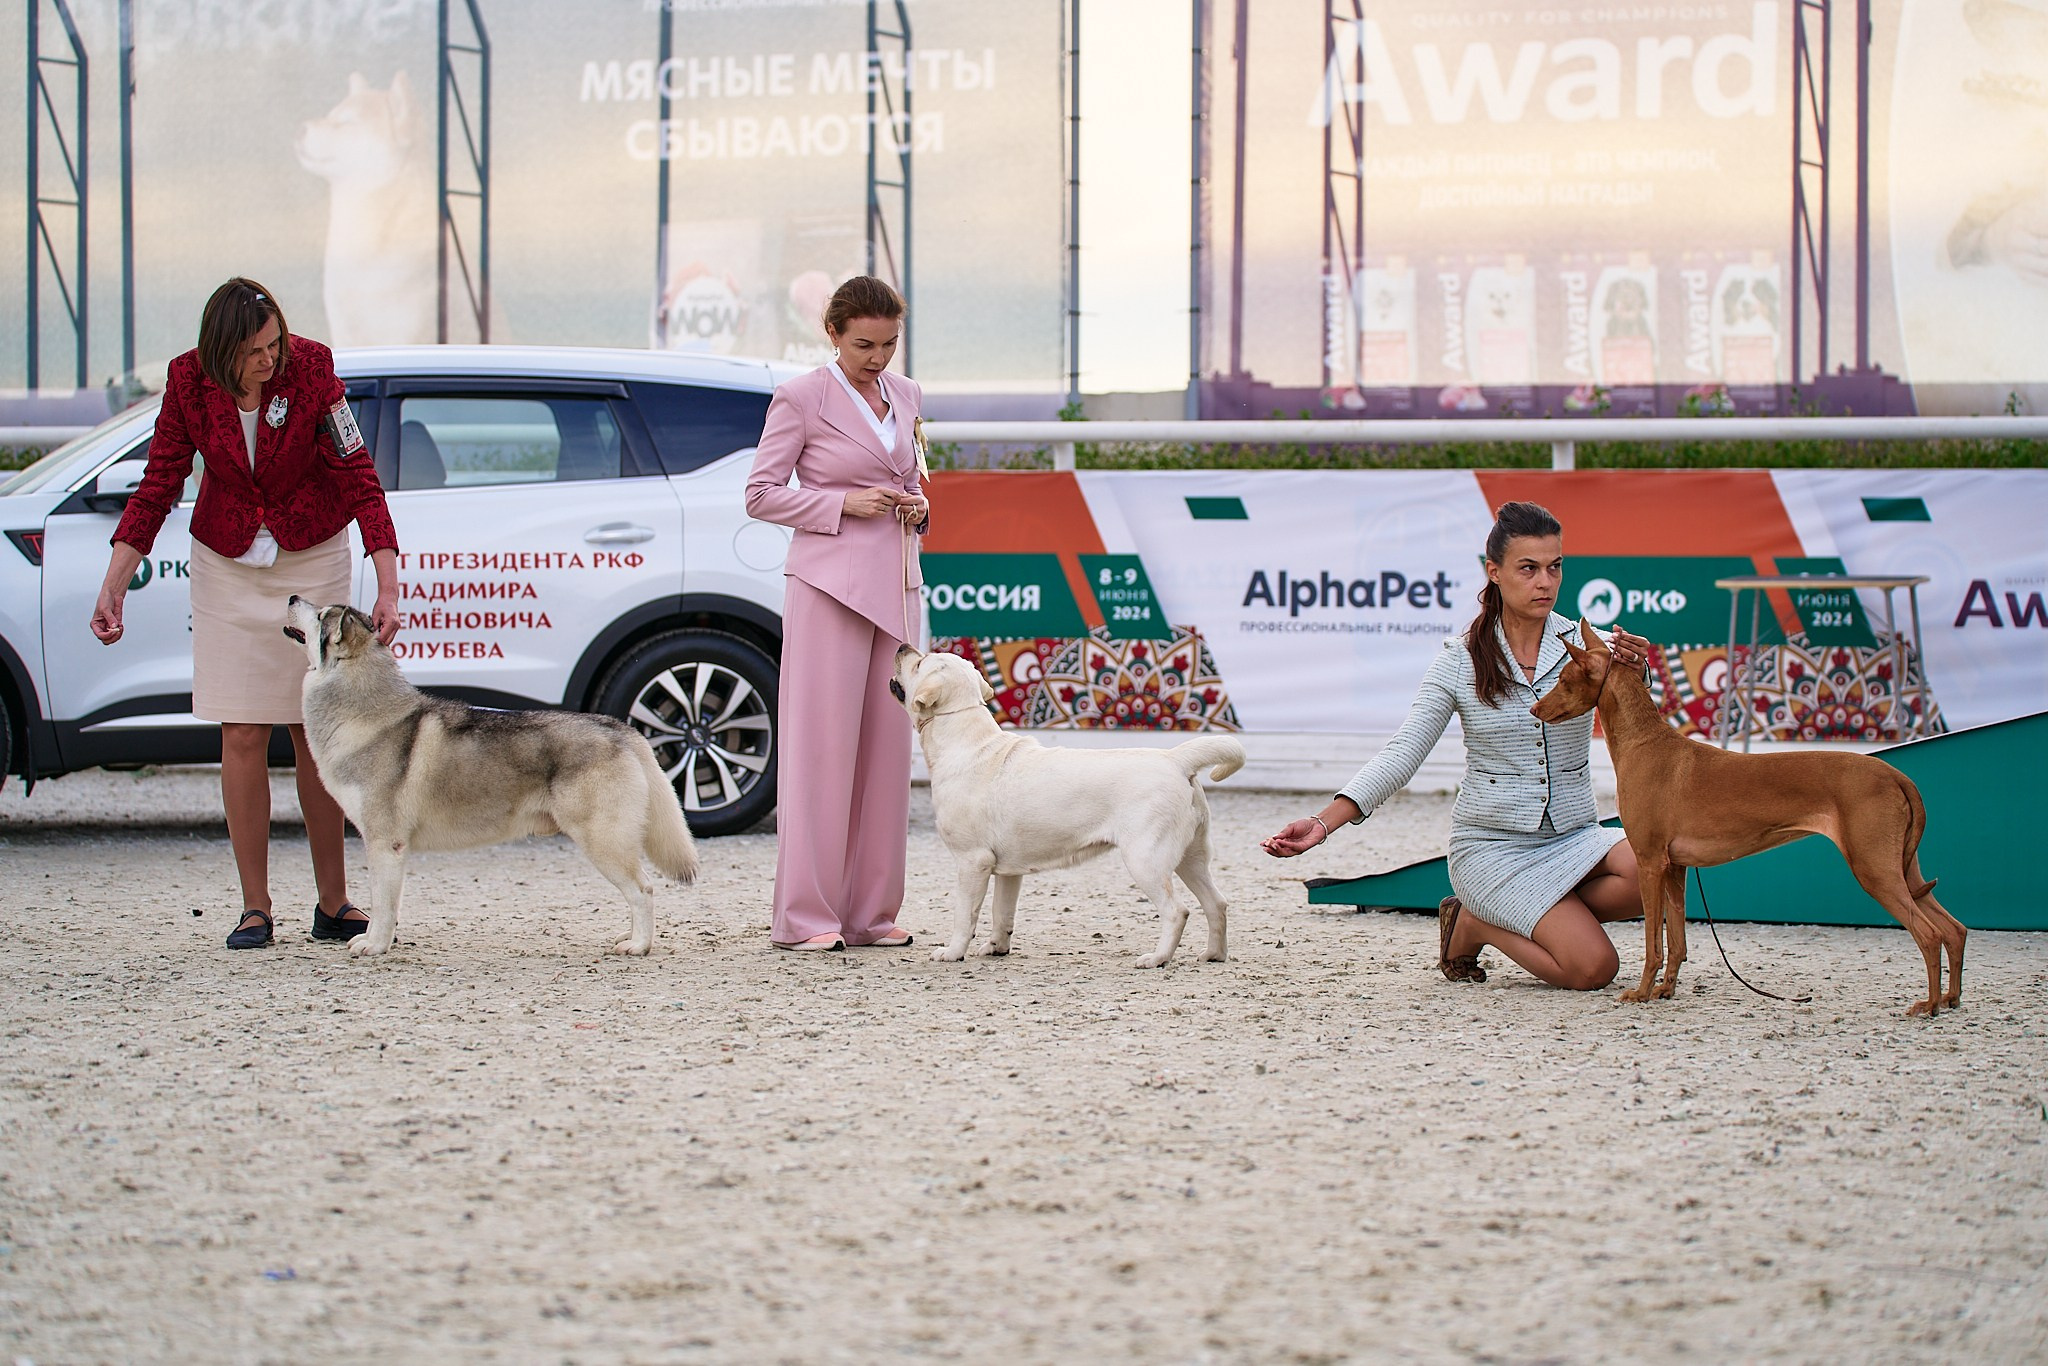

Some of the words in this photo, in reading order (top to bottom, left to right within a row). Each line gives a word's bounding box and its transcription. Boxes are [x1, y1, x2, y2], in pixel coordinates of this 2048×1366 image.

[1411, 11, 1512, 29] QUALITY
[1525, 9, 1571, 26] FOR
[1581, 4, 1729, 24] CHAMPIONS
[581, 53, 794, 101] МЯСНЫЕ
[810, 48, 996, 95] МЕЧТЫ
[1306, 0, 1778, 127] Award
[625, 112, 945, 160] СБЫВАЮТСЯ
[1325, 273, 1347, 371] Award
[1440, 272, 1463, 371] Award
[1563, 271, 1589, 374] Award
[1684, 270, 1712, 374] Award
[419, 552, 584, 572] ПРЕЗИДЕНТА
[593, 552, 644, 568] РКФ
[1099, 568, 1112, 585] 8
[1124, 568, 1137, 585] 9
[1099, 589, 1149, 602] ИЮНЯ
[1242, 570, 1453, 617] AlphaPet
[1626, 589, 1687, 614] РКФ
[1798, 594, 1850, 607] ИЮНЯ
[1112, 605, 1151, 620] 2024
[1812, 611, 1853, 627] 2024
[1239, 621, 1383, 634] ПРОФЕССИОНАЛЬНЫЕ
[1387, 622, 1453, 635] РАЦИОНЫ
